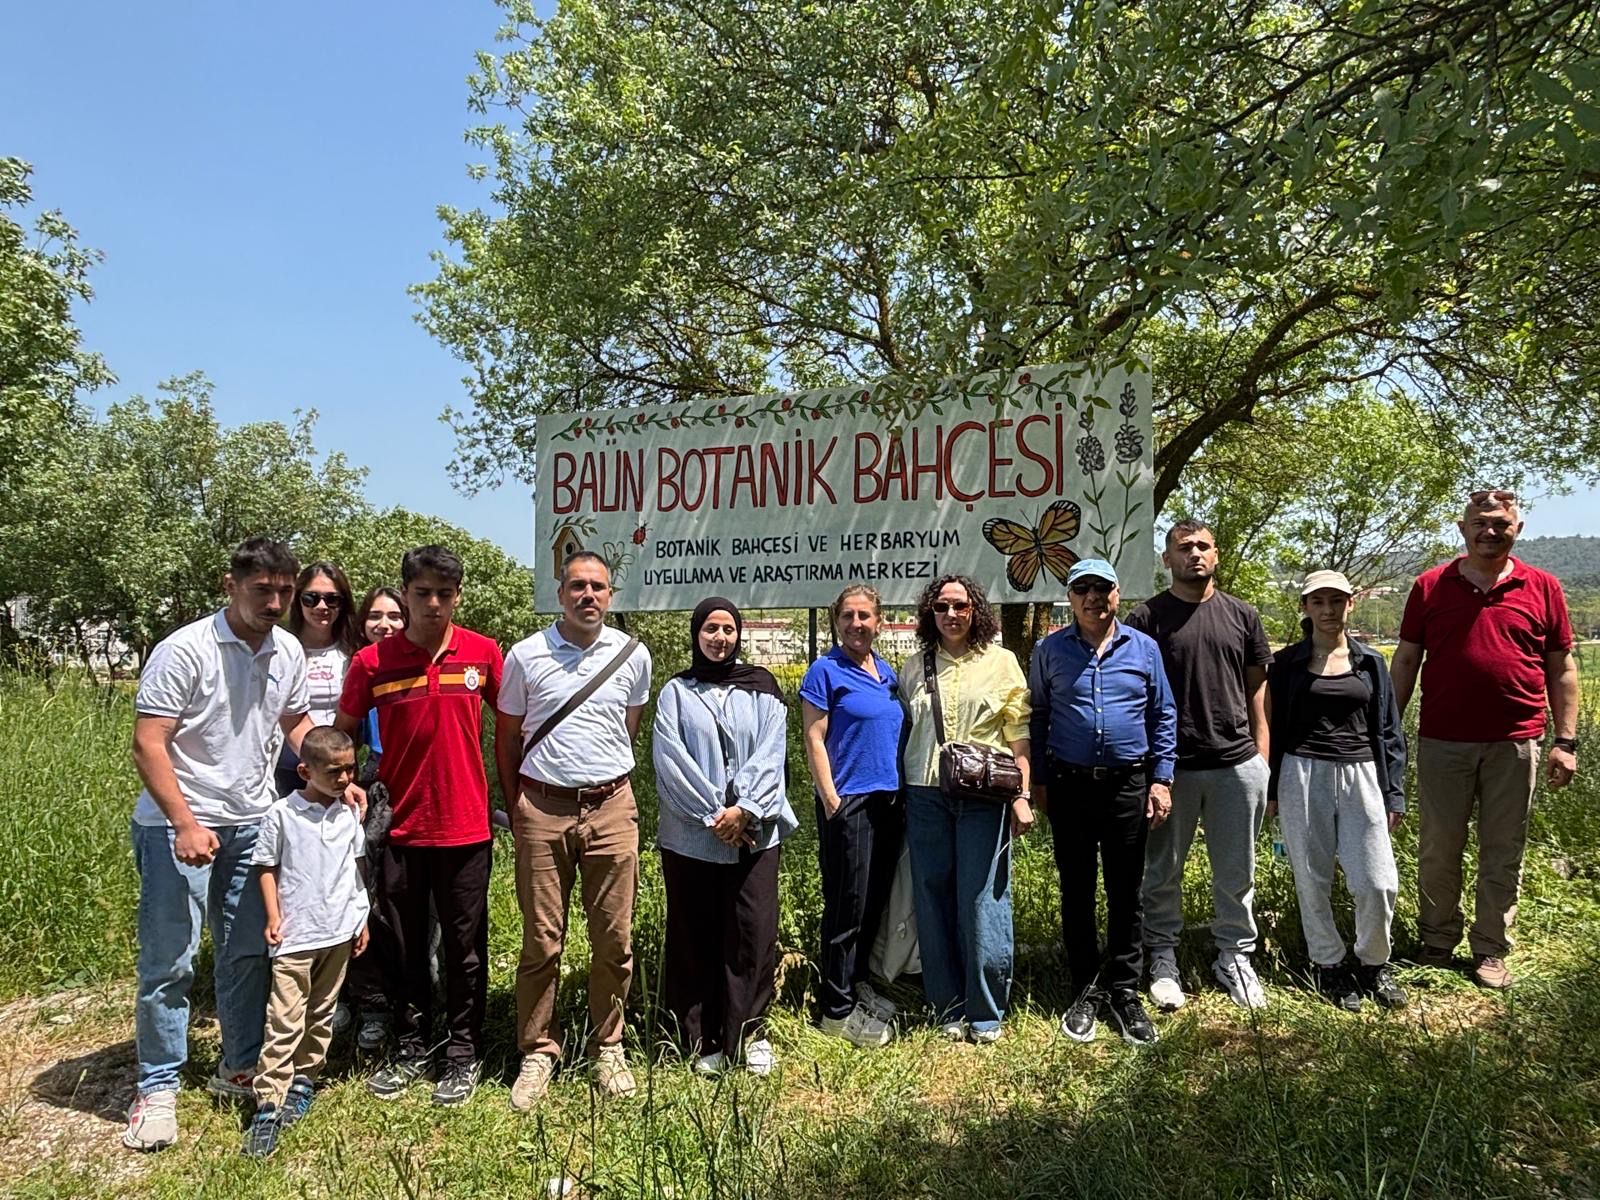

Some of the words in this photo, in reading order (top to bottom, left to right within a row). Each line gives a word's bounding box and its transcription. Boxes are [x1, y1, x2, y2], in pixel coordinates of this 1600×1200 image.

[552, 439, 644, 513] BAÜN
[657, 428, 838, 511] BOTANİK
[854, 403, 1064, 511] BAHÇESİ
[656, 536, 720, 558] BOTANİK
[732, 532, 798, 557] BAHÇESİ
[808, 536, 827, 552] VE
[841, 530, 960, 551] HERBARYUM
[645, 566, 724, 585] UYGULAMA
[730, 566, 746, 583] VE
[753, 564, 843, 584] ARAŞTIRMA
[849, 554, 938, 579] MERKEZİ
